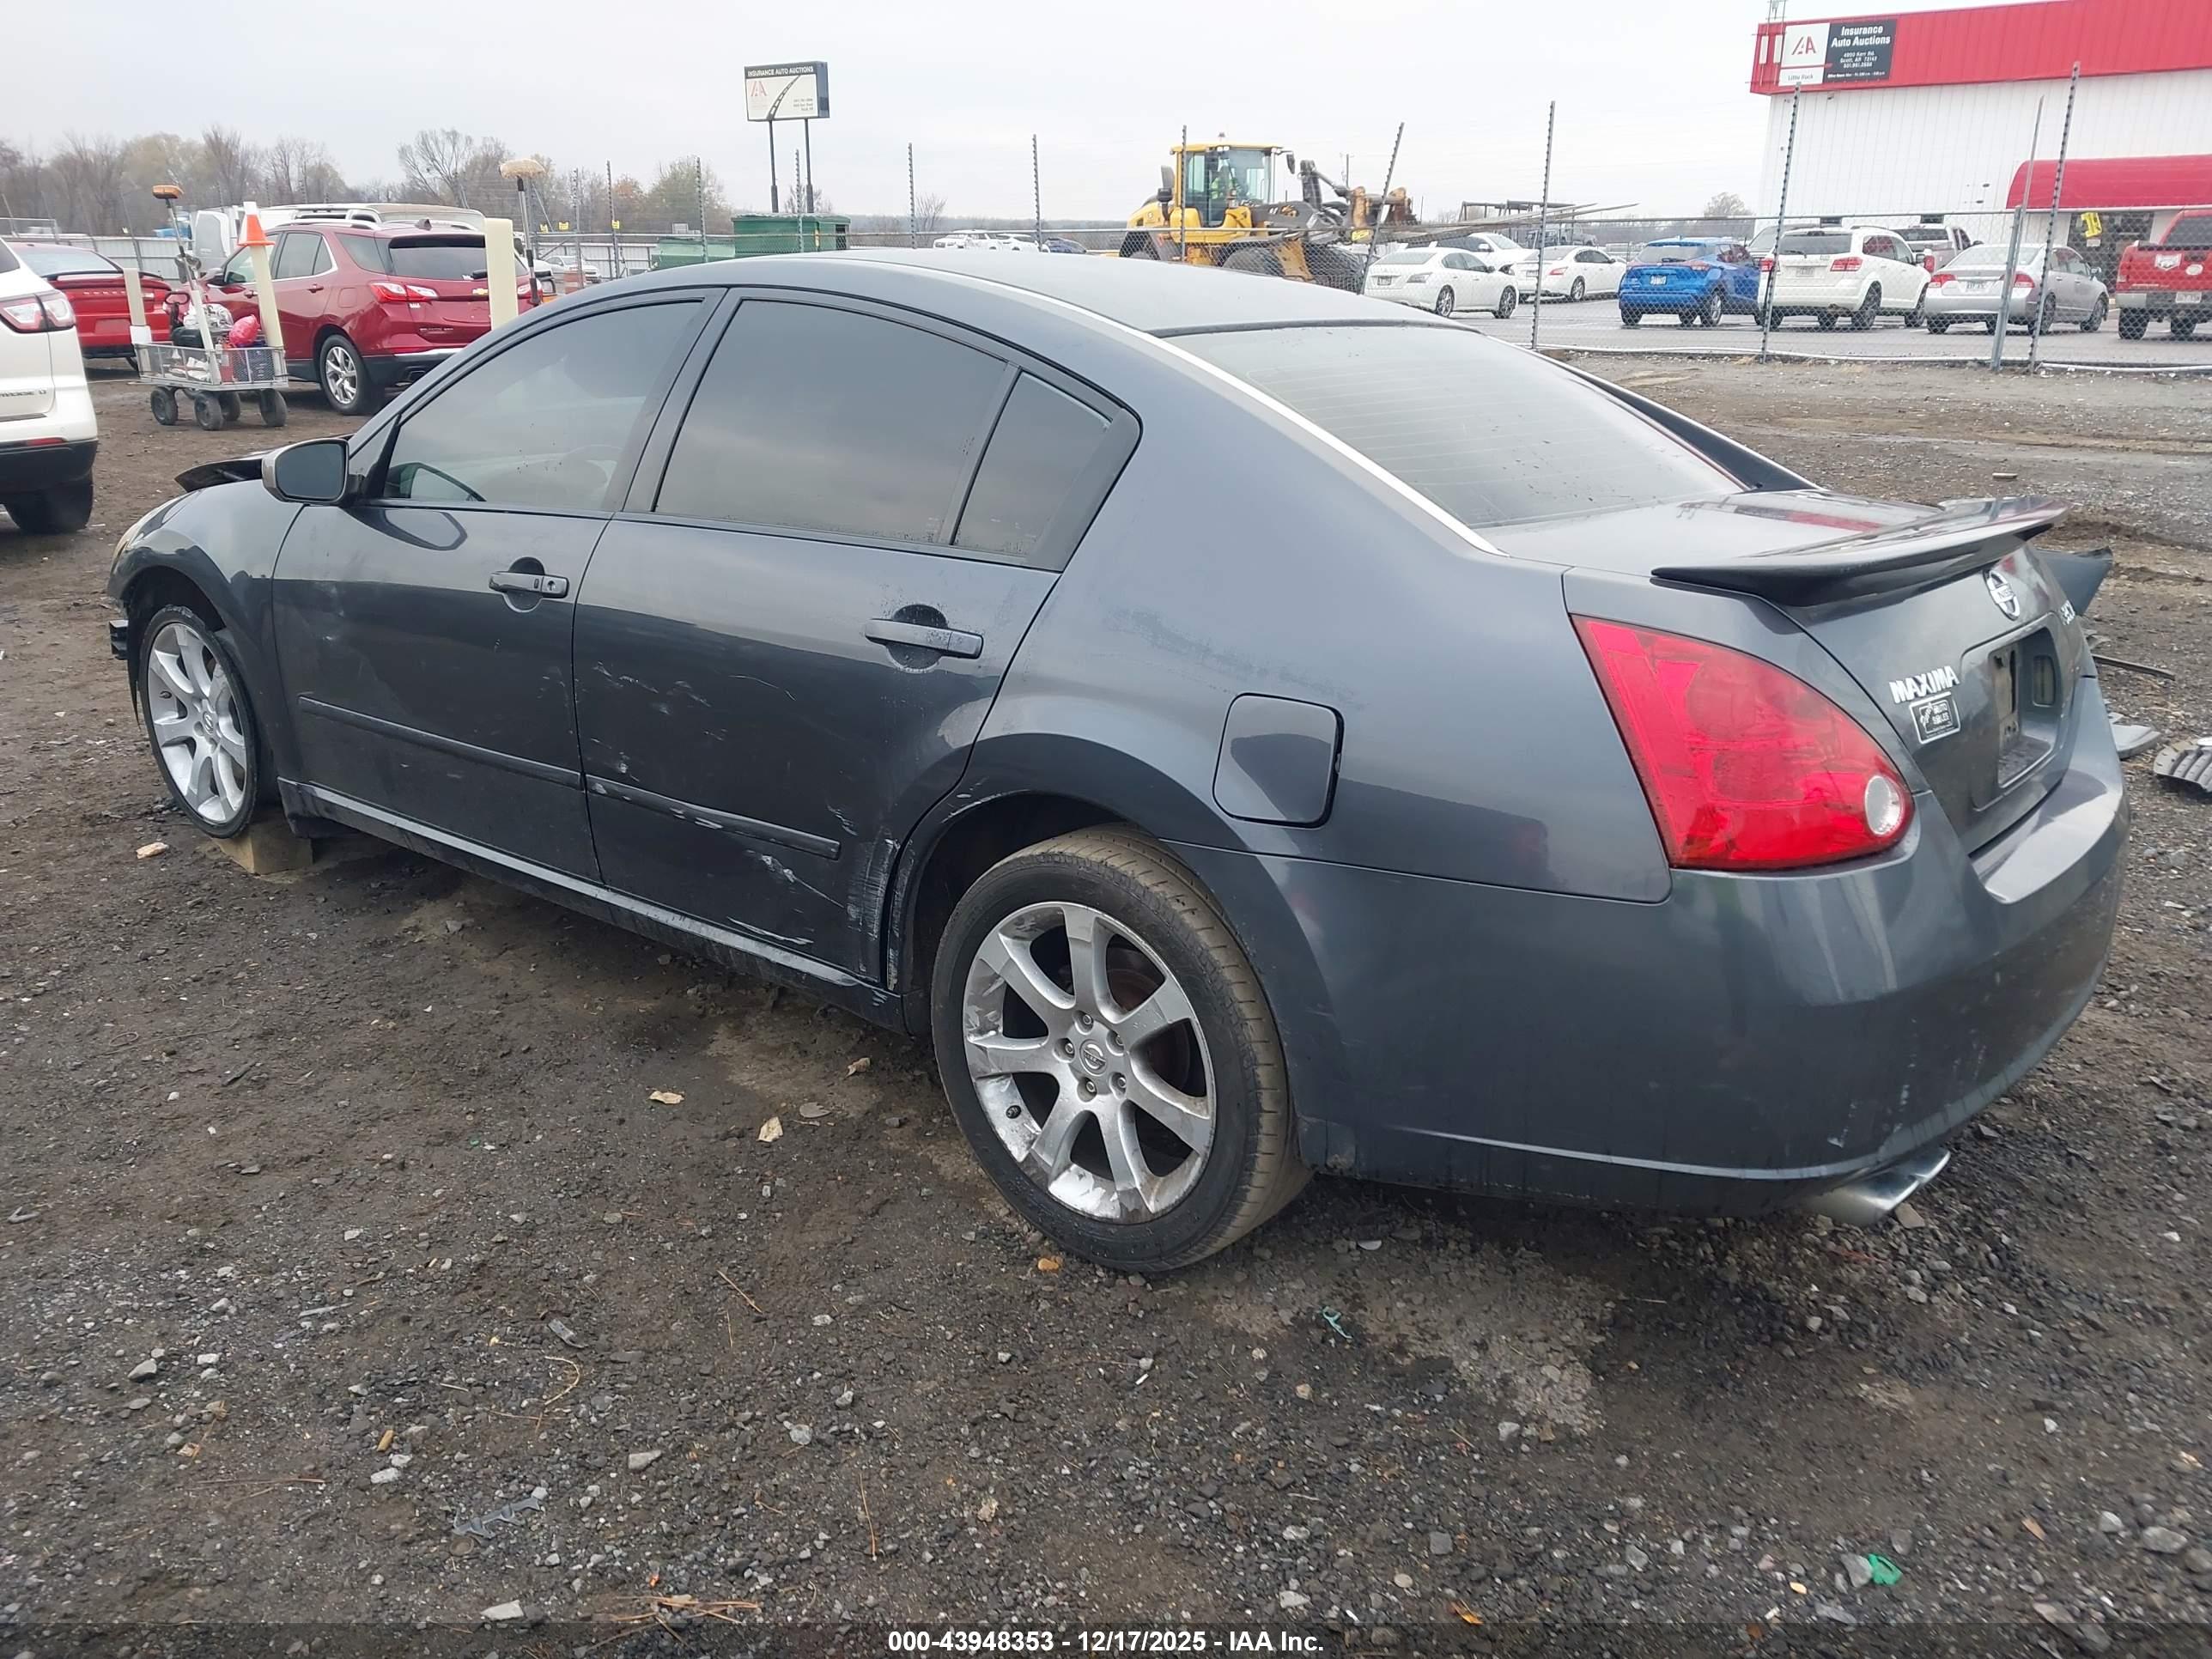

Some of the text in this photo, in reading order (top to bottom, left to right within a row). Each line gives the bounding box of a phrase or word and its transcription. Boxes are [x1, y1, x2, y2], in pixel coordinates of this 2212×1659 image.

[1841, 26, 1883, 35] Insurance
[1831, 35, 1890, 47] Auto Auctions
[1889, 665, 1960, 704] MAXIMA
